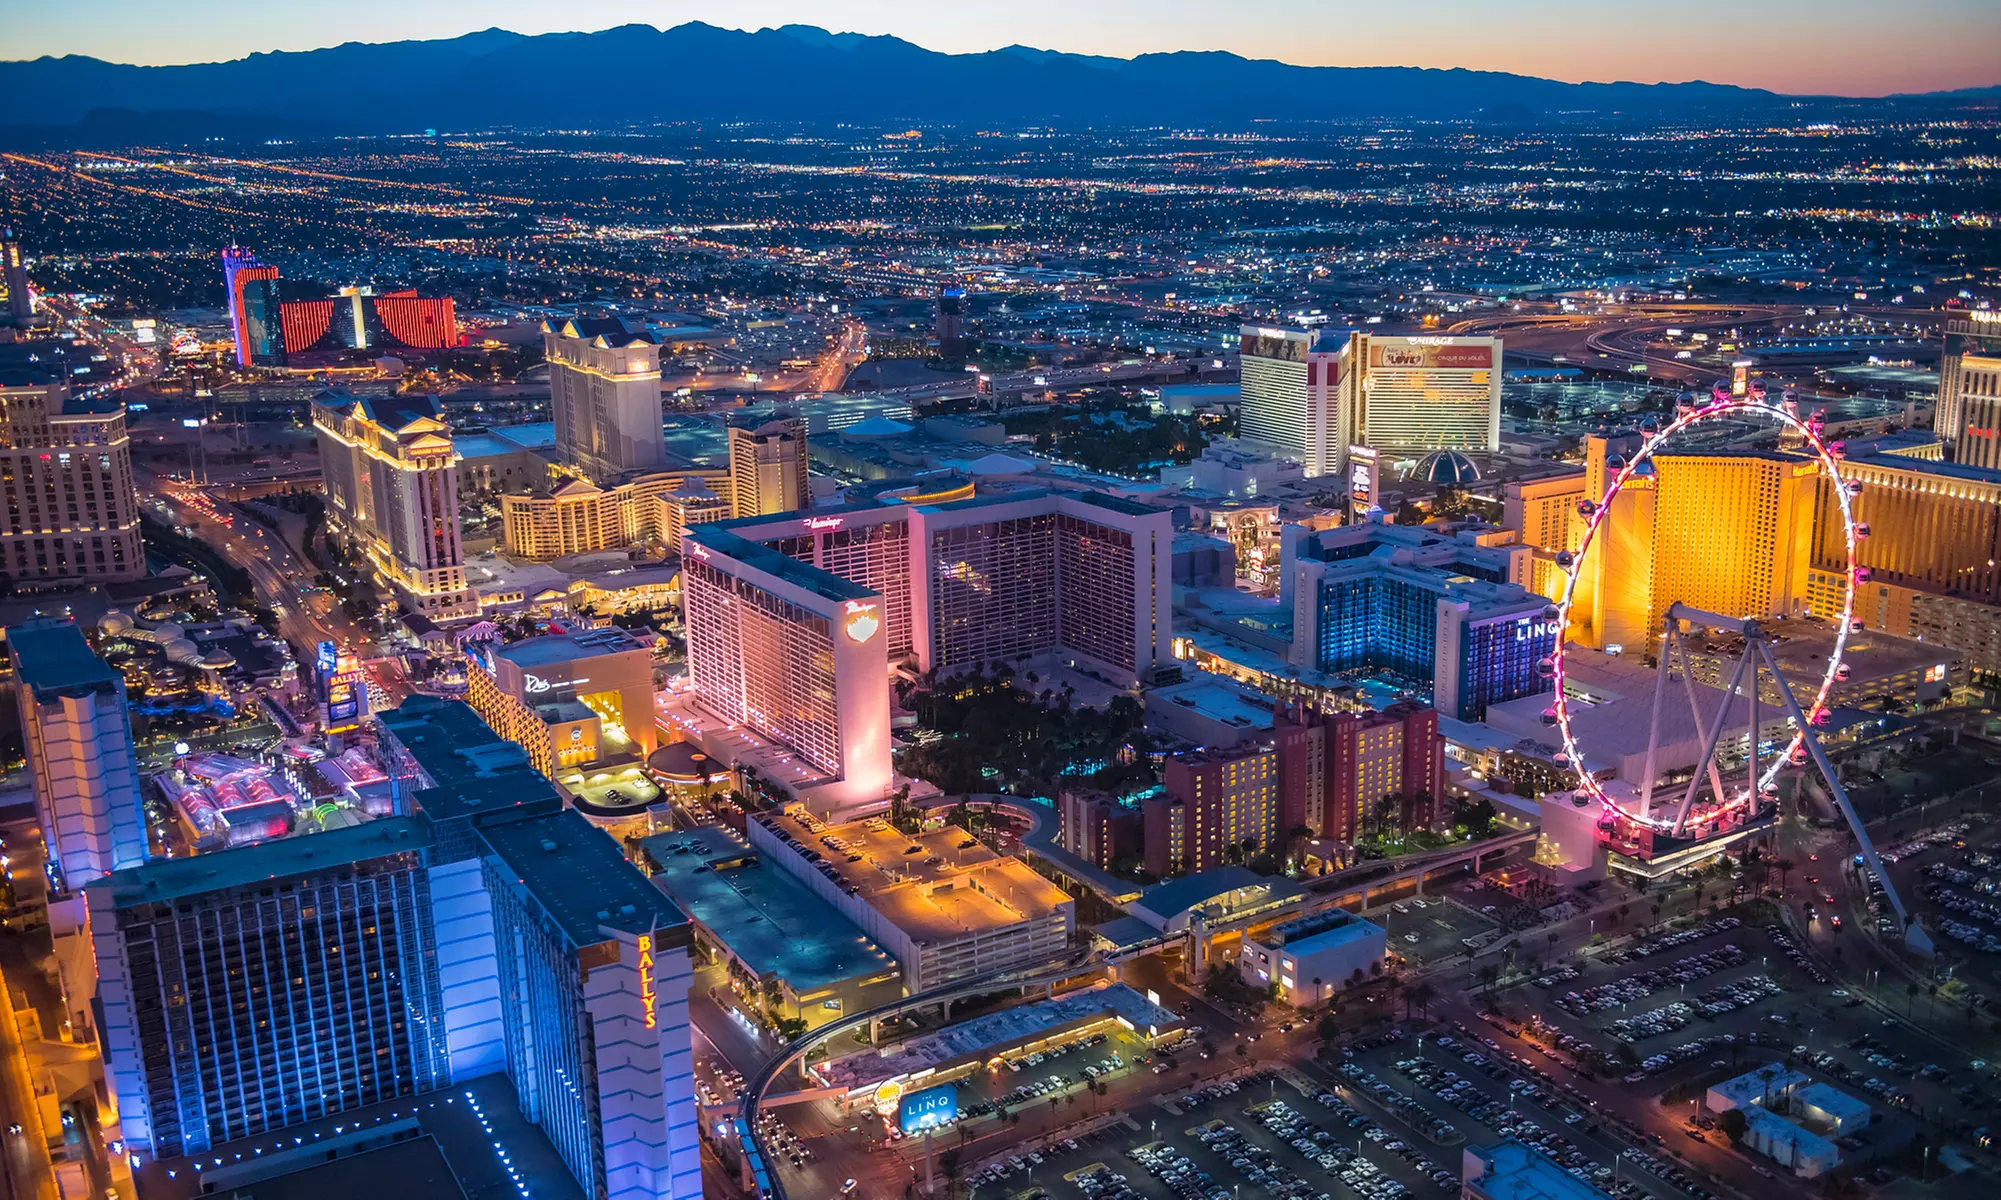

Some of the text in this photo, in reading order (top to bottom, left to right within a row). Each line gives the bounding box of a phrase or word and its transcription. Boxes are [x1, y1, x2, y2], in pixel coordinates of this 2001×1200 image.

[1621, 475, 1654, 490] arrah's
[803, 517, 843, 530] Flamingo
[1518, 617, 1530, 625] THE
[908, 1096, 948, 1116] LINQ
